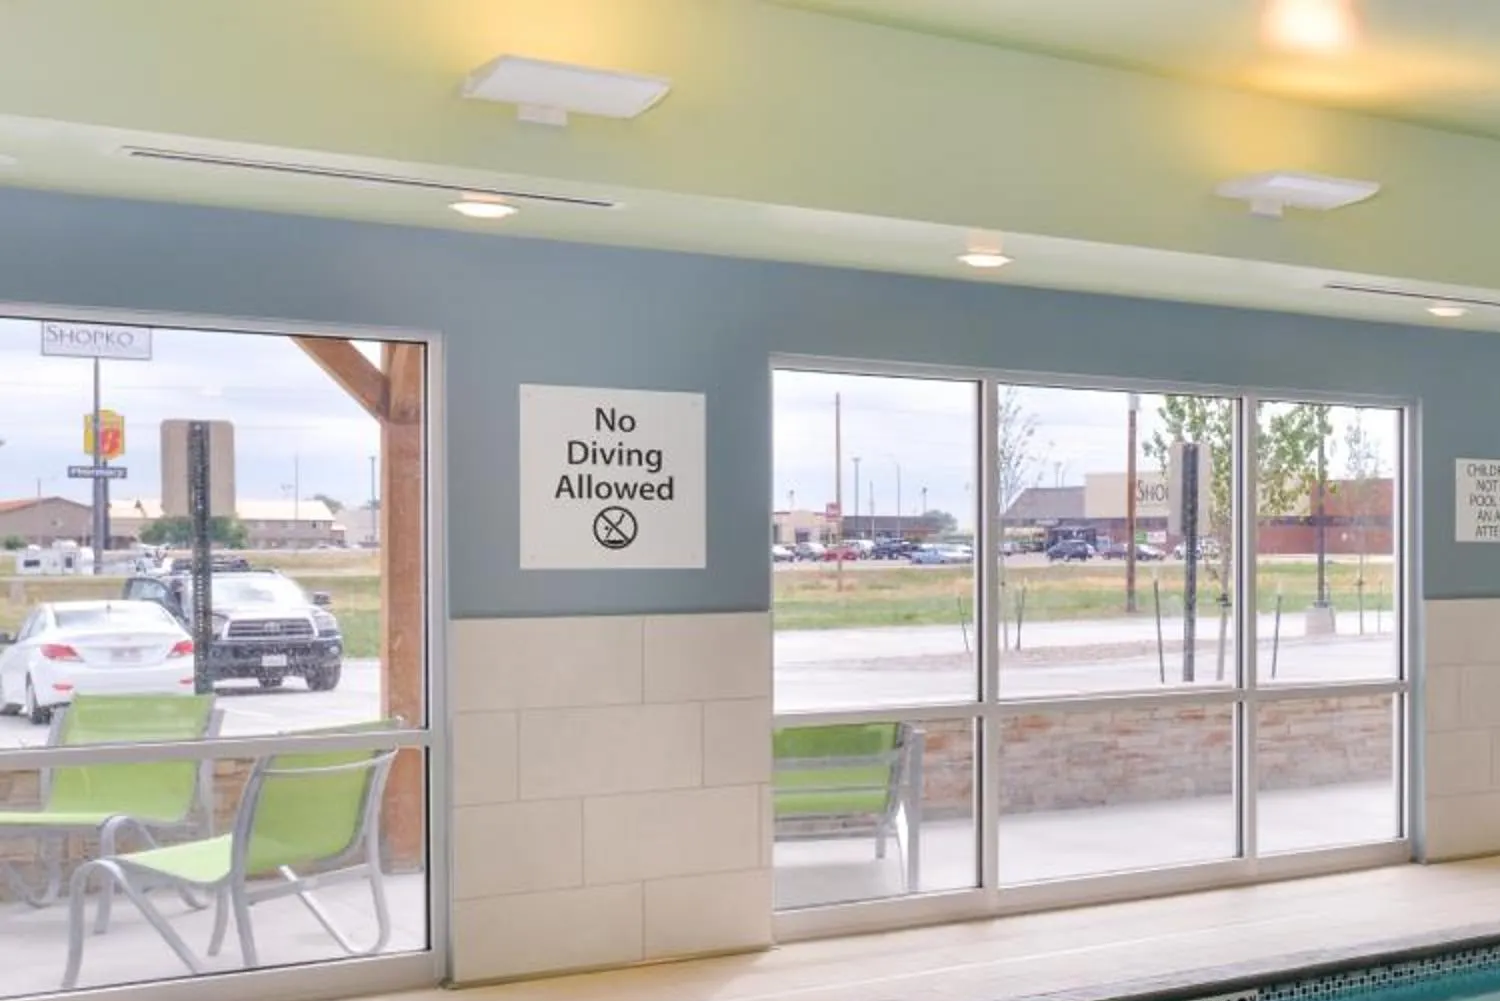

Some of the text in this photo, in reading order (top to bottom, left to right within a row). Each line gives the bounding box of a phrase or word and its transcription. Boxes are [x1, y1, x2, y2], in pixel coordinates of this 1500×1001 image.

[595, 406, 636, 433] No
[567, 439, 664, 474] Diving
[554, 473, 675, 501] Allowed
[1475, 479, 1498, 492] NOT
[1469, 493, 1497, 507] POOL
[1477, 510, 1493, 521] AN
